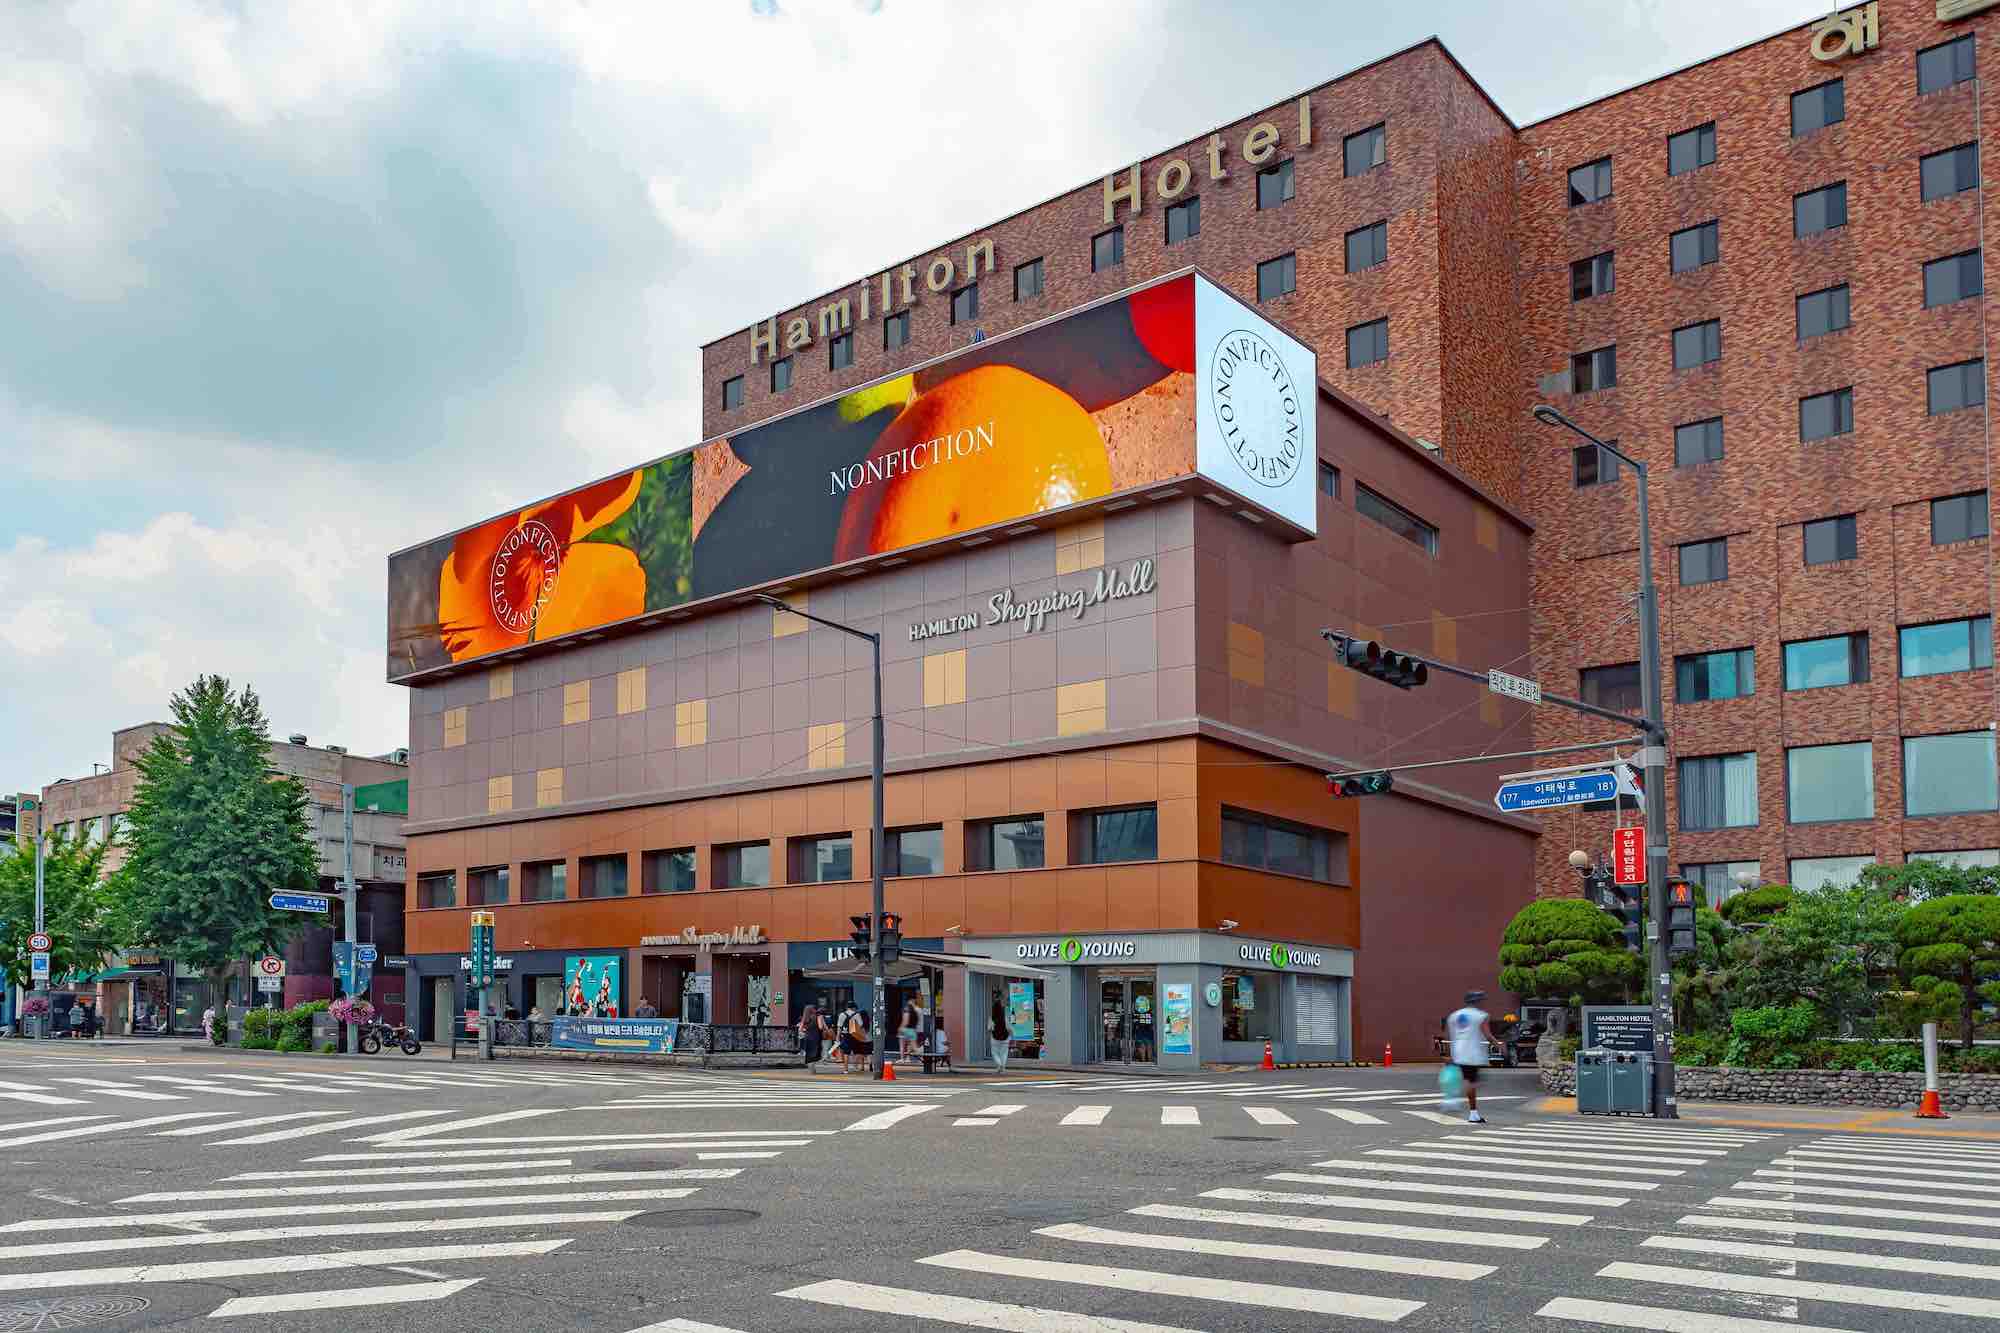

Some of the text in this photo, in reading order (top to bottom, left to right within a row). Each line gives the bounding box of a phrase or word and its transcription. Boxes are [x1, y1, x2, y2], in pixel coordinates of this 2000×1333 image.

[750, 94, 1312, 365] Hamilton Hotel
[829, 421, 996, 495] NONFICTION
[909, 559, 1154, 641] HAMILTON Shopping Mall
[1535, 780, 1577, 793] 이태원로
[1597, 782, 1614, 791] 181
[1503, 792, 1519, 803] 177
[1521, 796, 1561, 806] Itaewon-ro
[33, 938, 46, 947] 50
[1016, 941, 1136, 958] OLIVE YOUNG
[1240, 945, 1321, 966] OLIVE YOUNG
